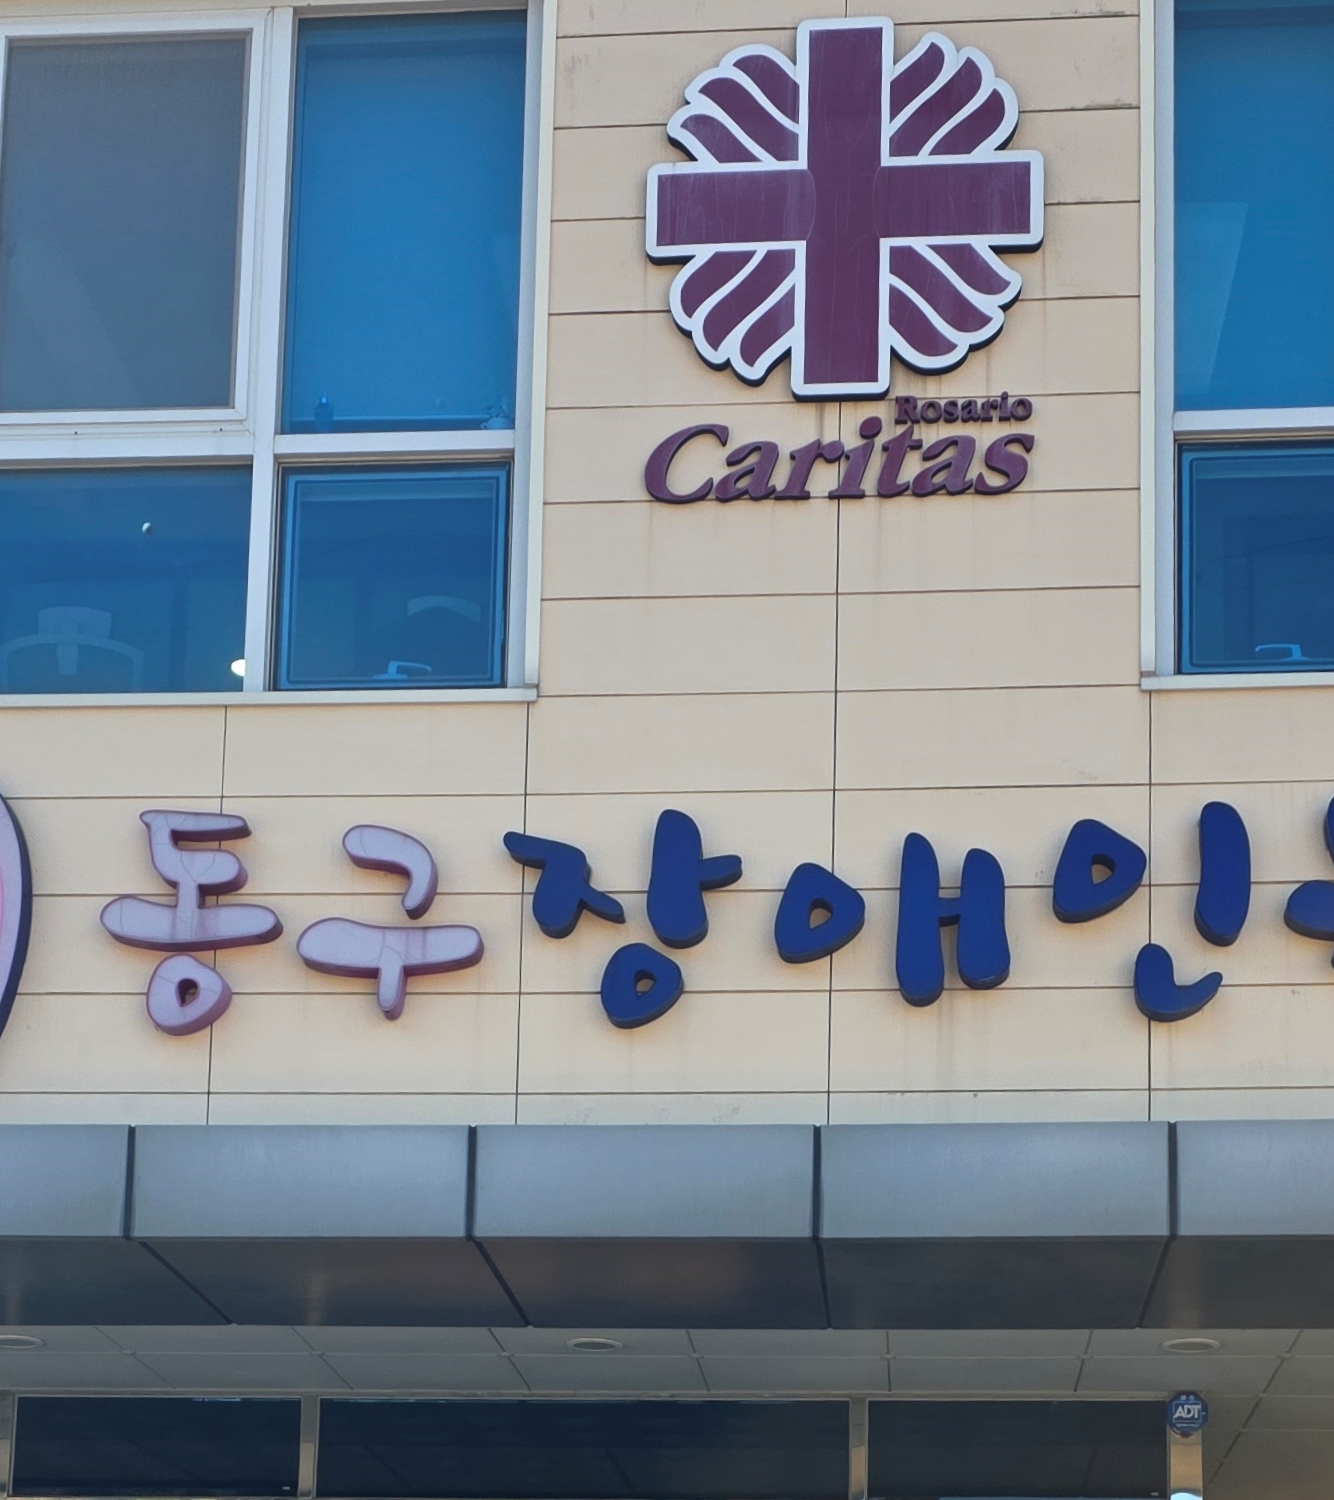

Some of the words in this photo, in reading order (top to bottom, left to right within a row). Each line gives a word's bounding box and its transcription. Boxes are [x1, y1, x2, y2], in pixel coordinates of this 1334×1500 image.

[895, 391, 1033, 424] Rosario
[644, 416, 1035, 504] Caritas
[1173, 1404, 1201, 1419] ADT
